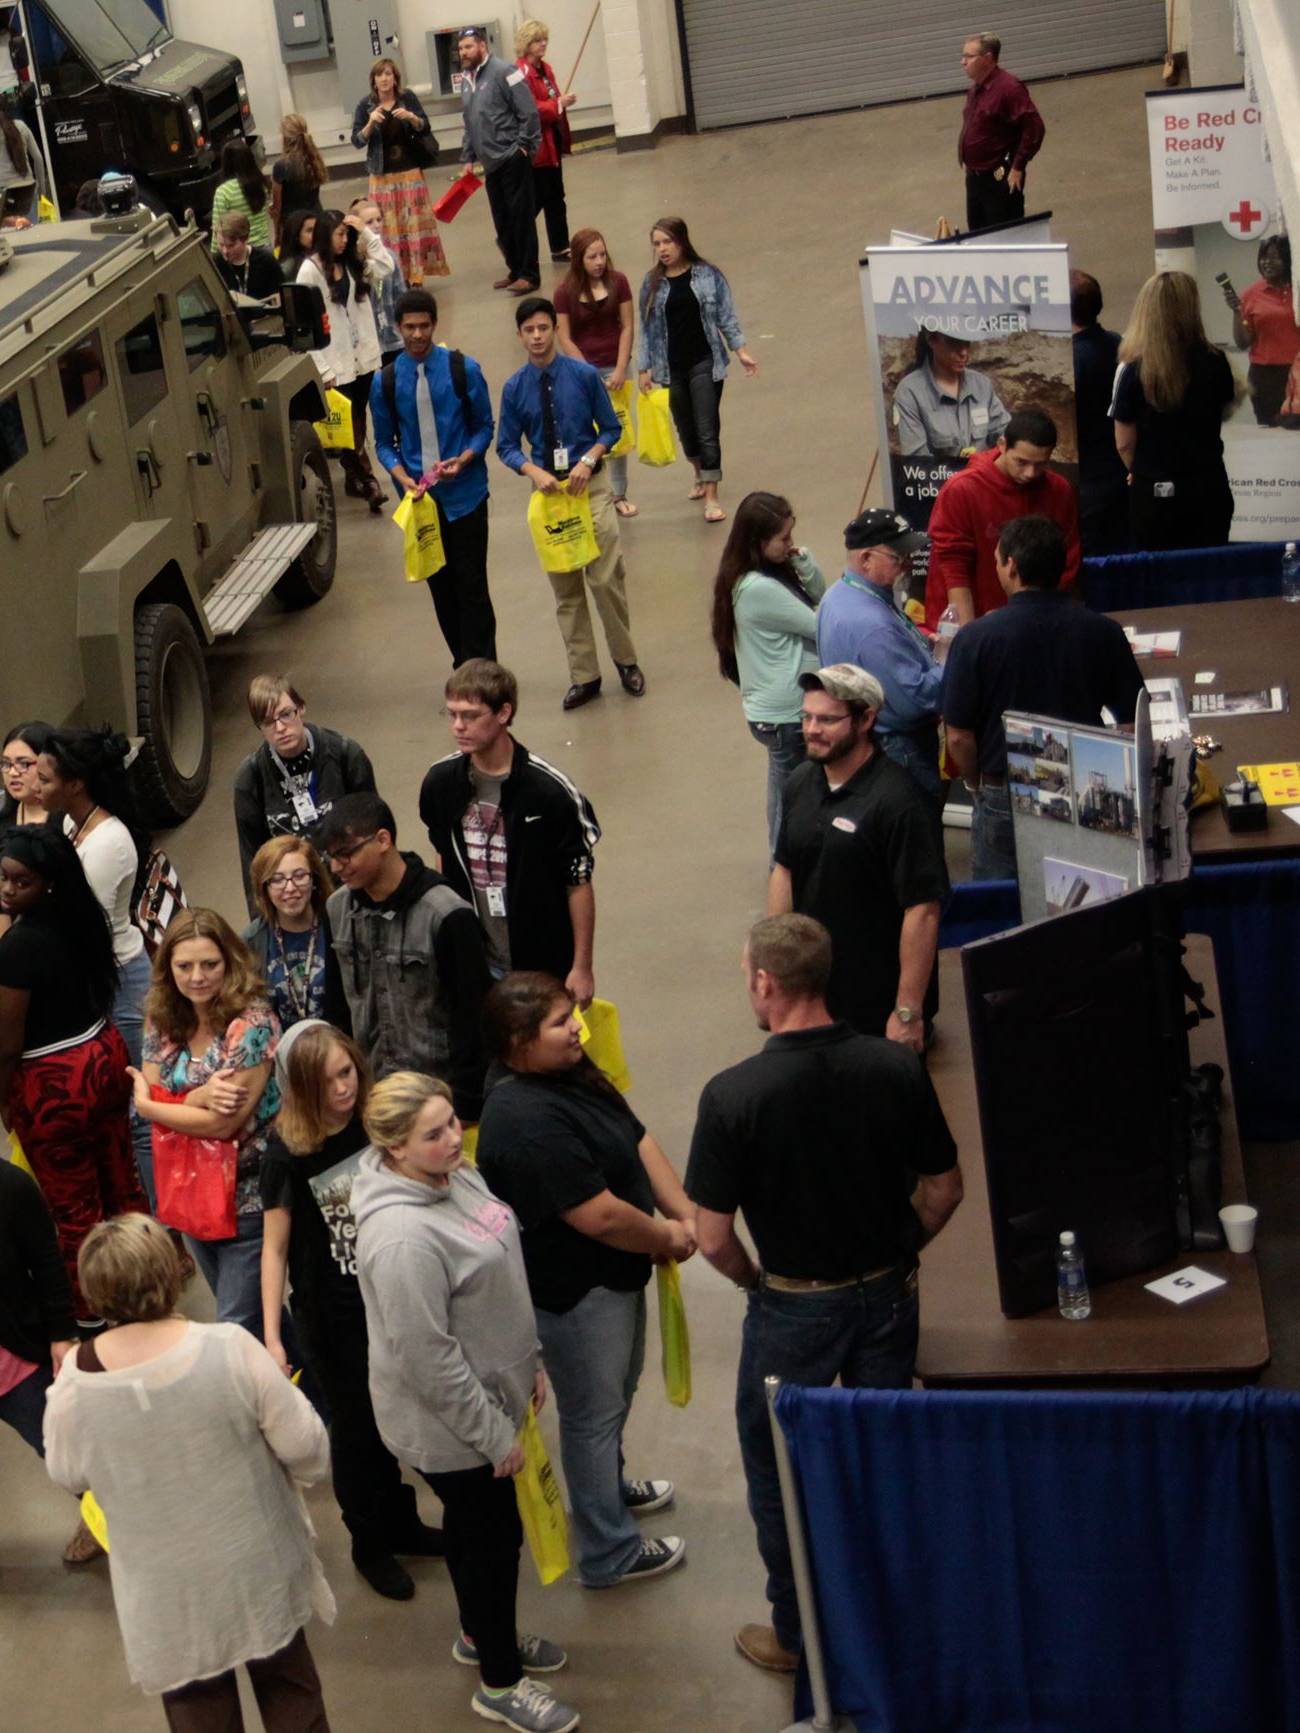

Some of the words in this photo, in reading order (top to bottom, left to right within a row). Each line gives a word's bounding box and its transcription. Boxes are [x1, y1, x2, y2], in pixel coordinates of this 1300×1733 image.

[1164, 115, 1190, 131] Be
[1197, 110, 1235, 128] Red
[1165, 133, 1225, 152] Ready
[1165, 157, 1181, 166] Get
[1166, 171, 1188, 179] Make
[1166, 184, 1178, 192] Be
[890, 275, 1050, 305] ADVANCE
[914, 315, 960, 332] YOUR
[964, 314, 1028, 333] CAREER
[903, 465, 926, 480] We
[1255, 478, 1276, 487] Red
[905, 486, 914, 496] a
[917, 482, 939, 501] job
